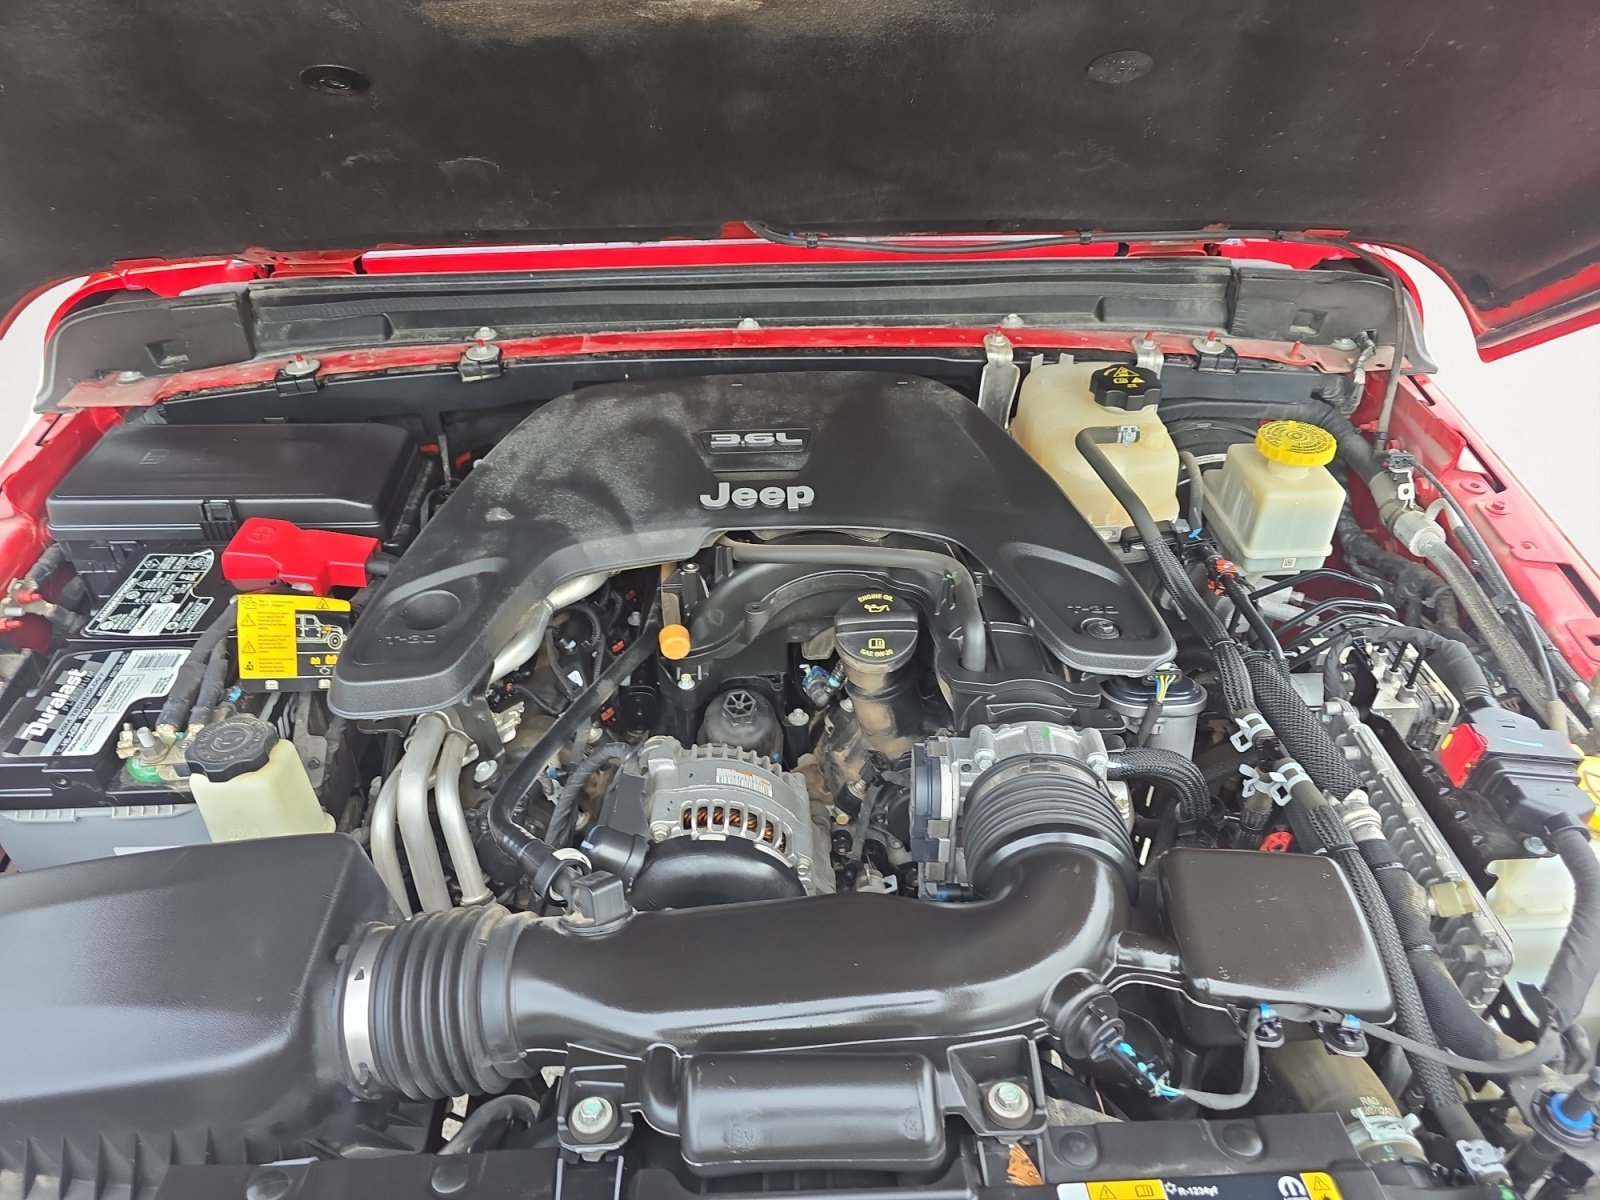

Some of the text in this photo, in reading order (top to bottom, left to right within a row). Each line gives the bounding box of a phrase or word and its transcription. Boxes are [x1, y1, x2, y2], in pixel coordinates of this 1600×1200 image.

[710, 432, 803, 448] 3.6L
[699, 482, 815, 511] Jeep
[857, 593, 894, 603] ENGINE OIL
[860, 648, 894, 658] SAE 0W-20
[71, 672, 104, 717] TECHNOLOGY
[20, 668, 88, 738] Duralast
[1178, 1185, 1219, 1197] R-1234yf
